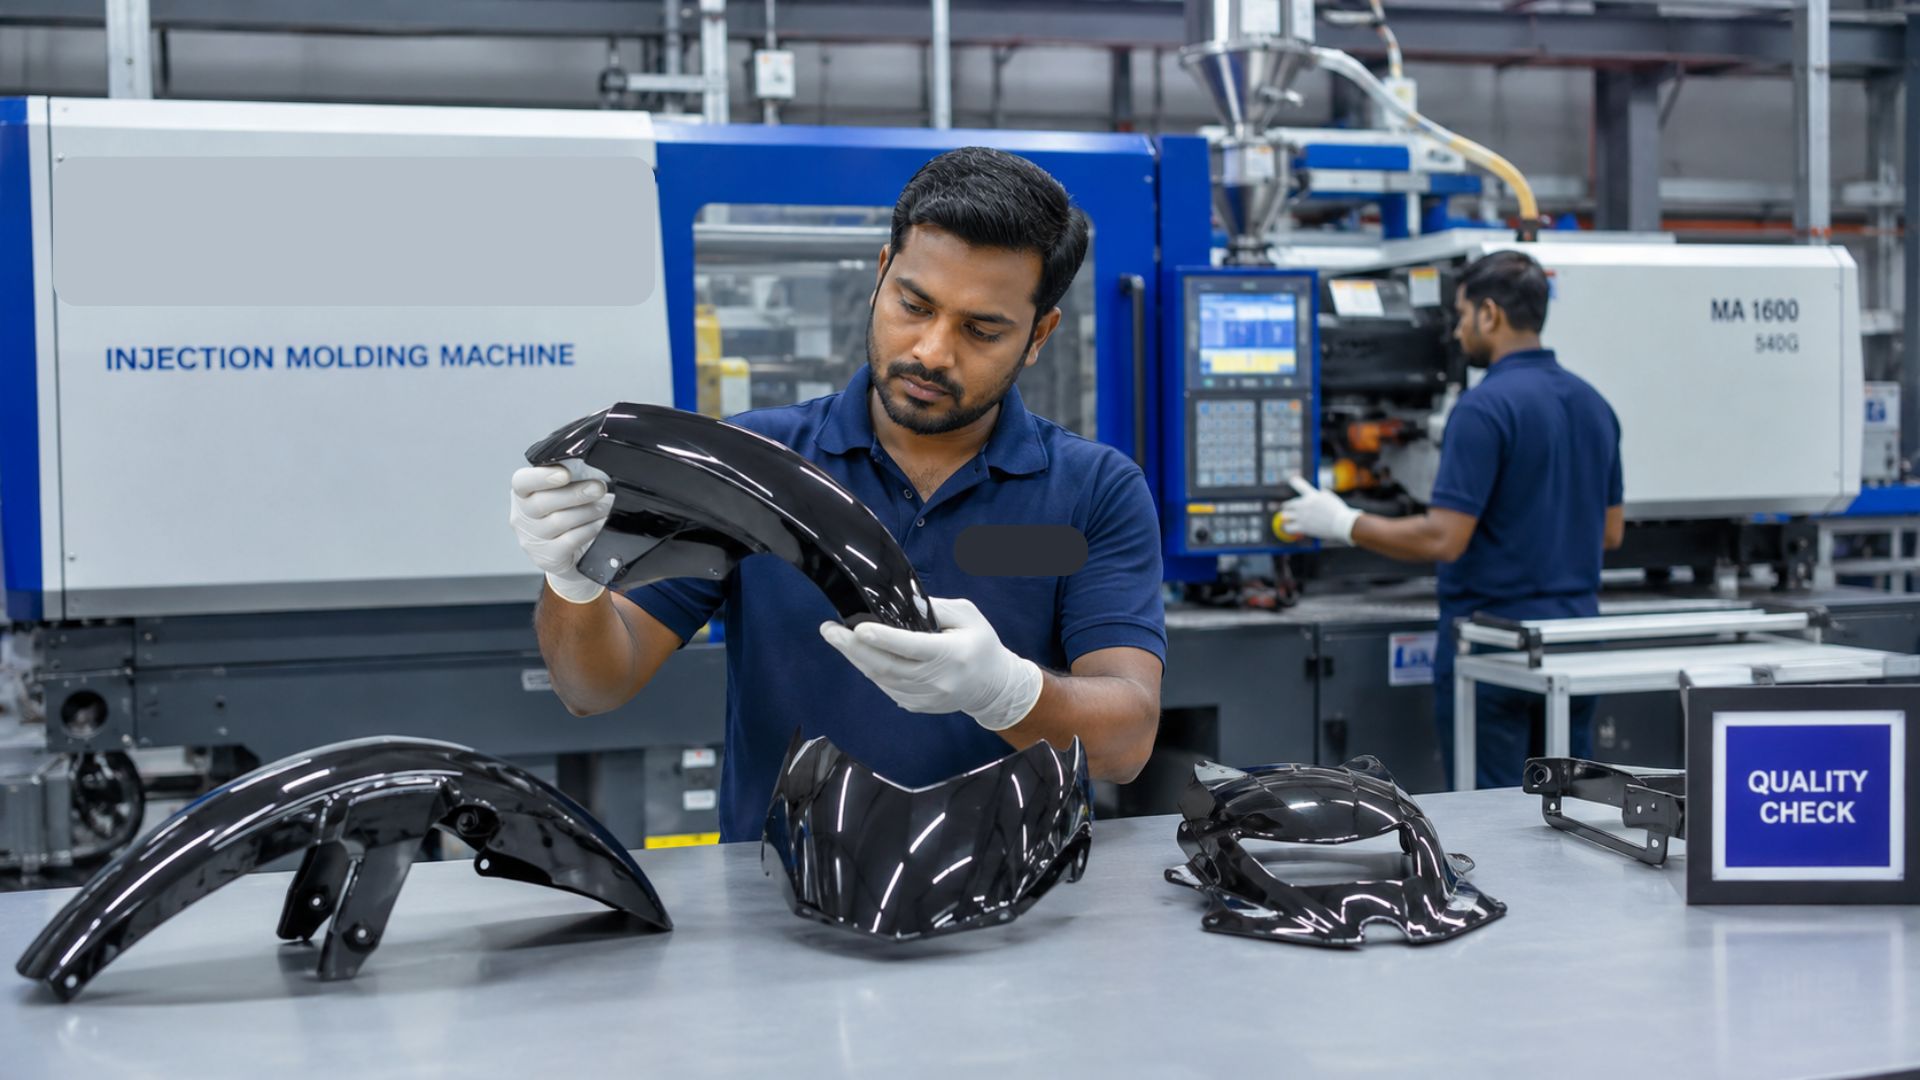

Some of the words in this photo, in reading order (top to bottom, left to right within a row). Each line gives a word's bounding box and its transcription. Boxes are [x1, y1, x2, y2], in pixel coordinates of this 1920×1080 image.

[1711, 299, 1745, 321] MA
[1753, 299, 1799, 322] 1600
[105, 345, 275, 372] INJECTION
[285, 344, 430, 370] MOLDING
[439, 343, 575, 368] MACHINE
[1748, 769, 1868, 796] QUALITY
[1759, 800, 1856, 824] CHECK
